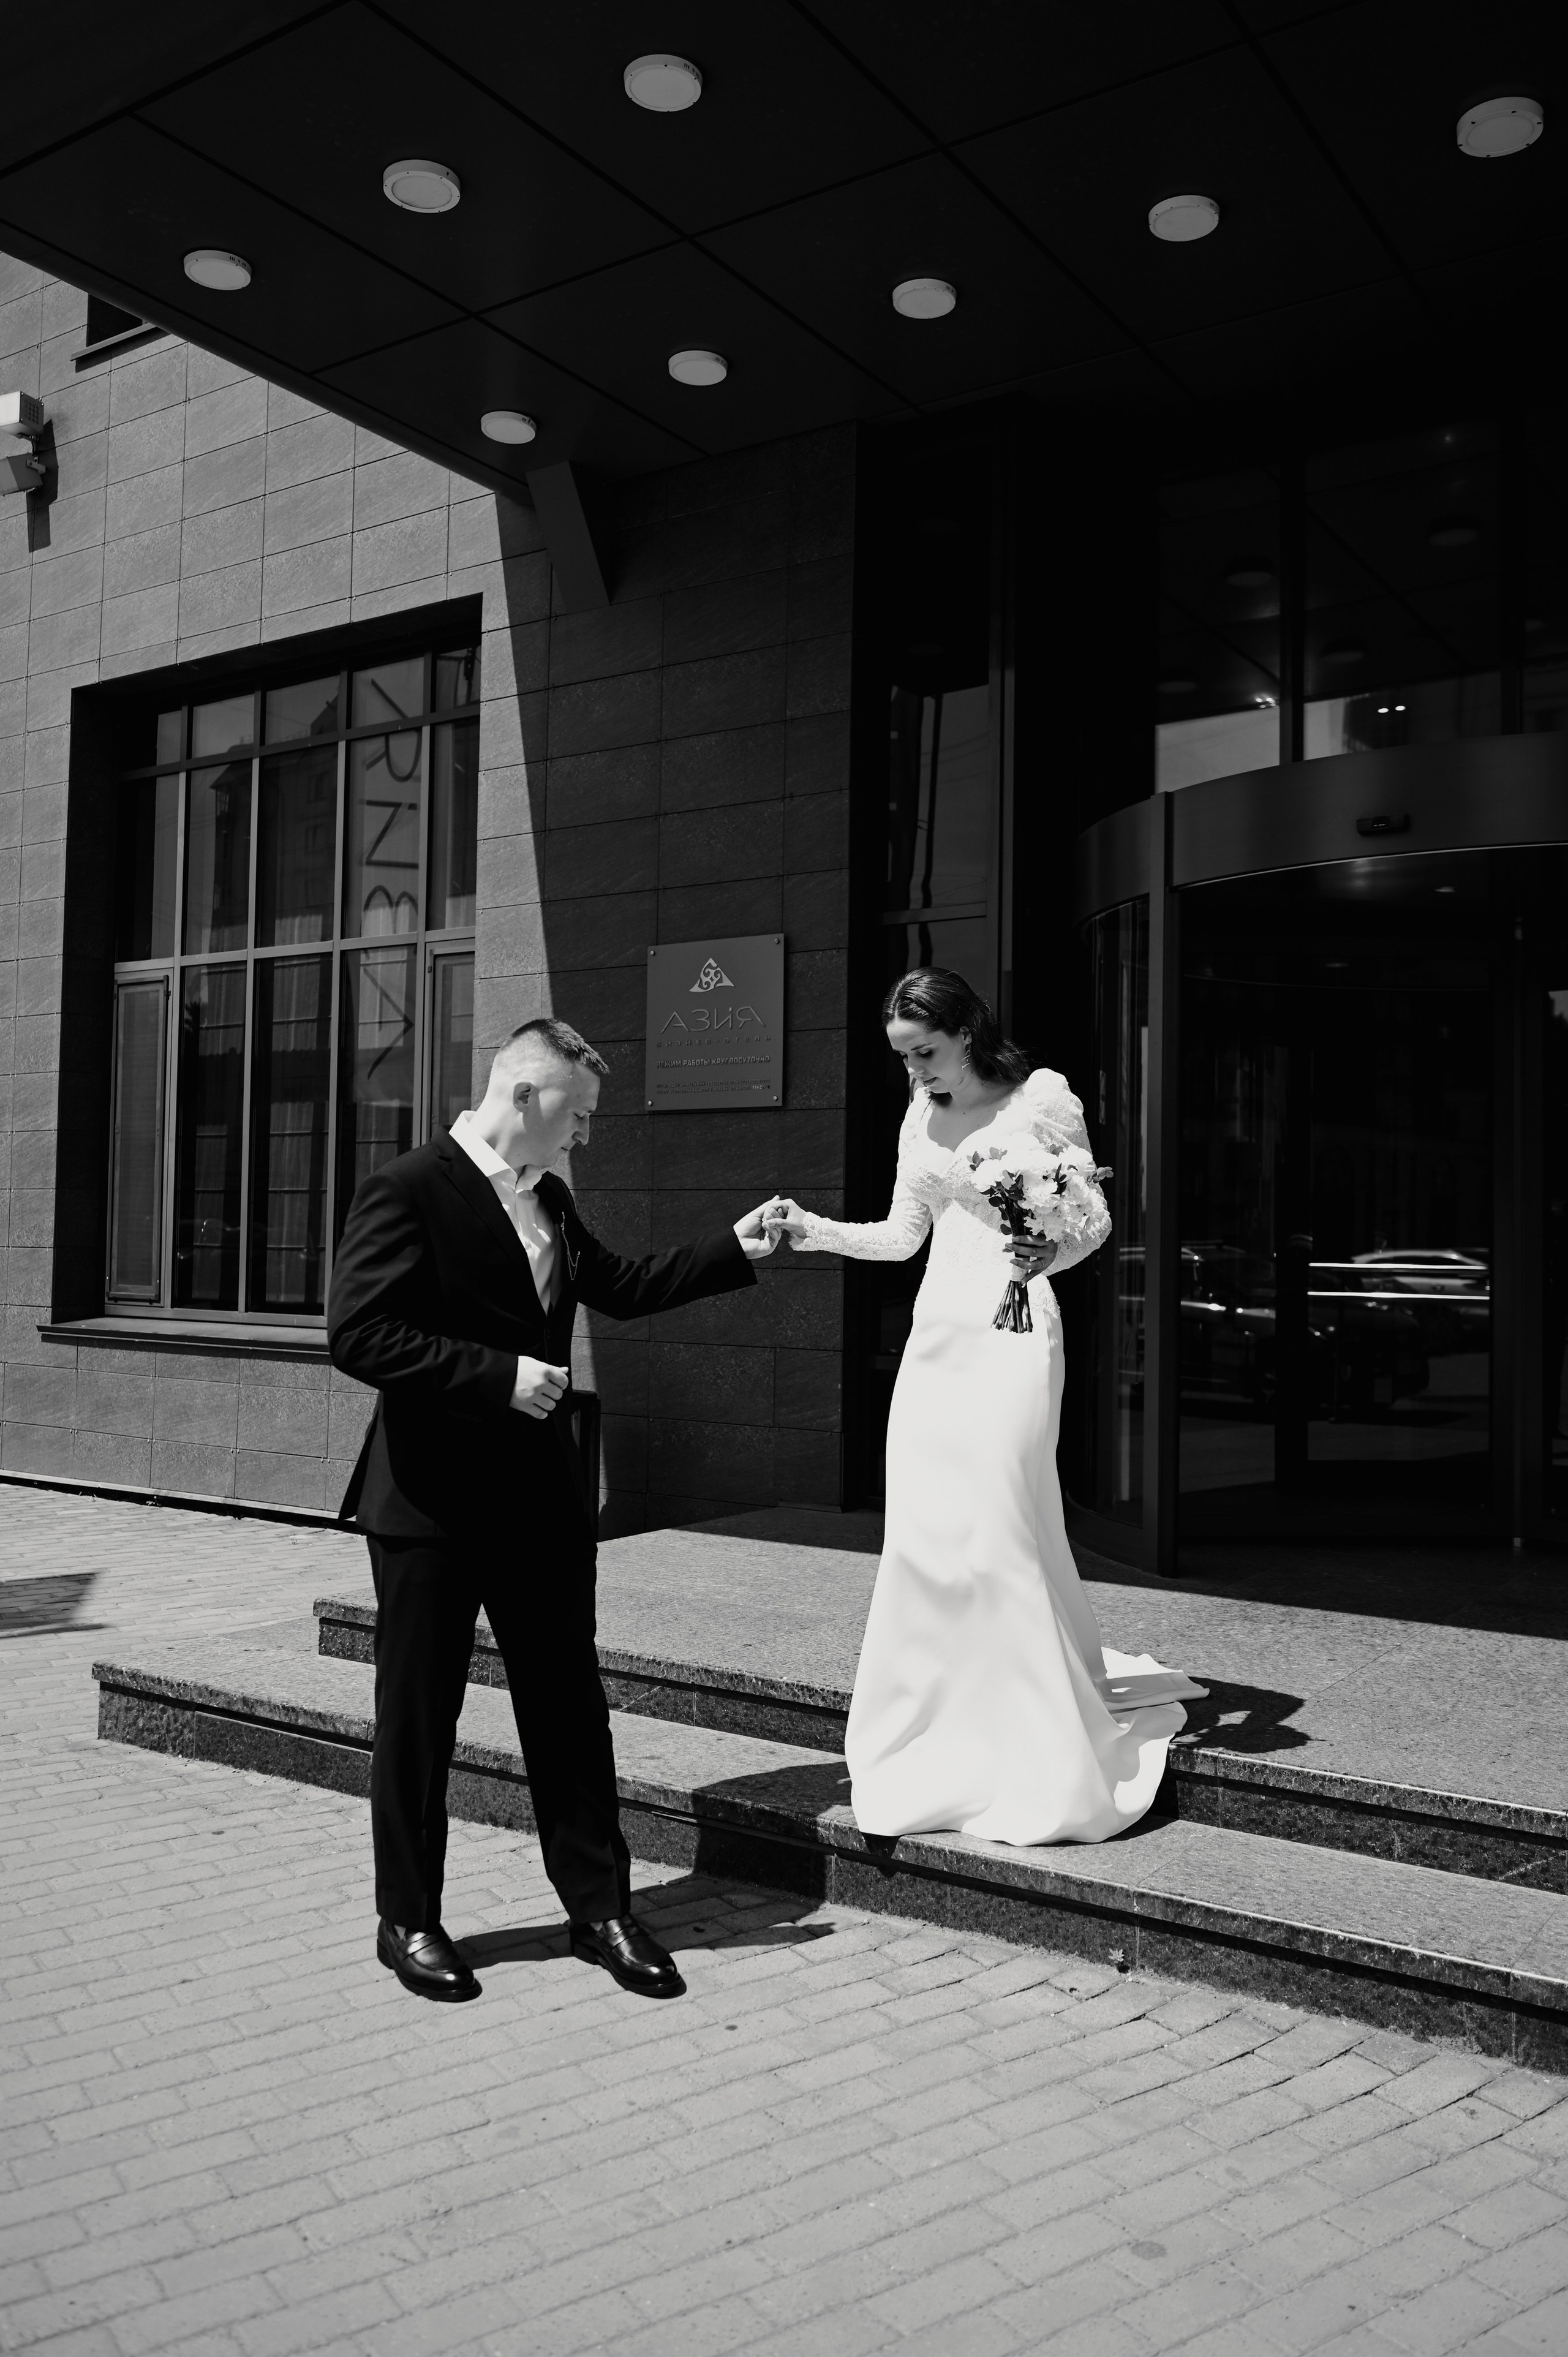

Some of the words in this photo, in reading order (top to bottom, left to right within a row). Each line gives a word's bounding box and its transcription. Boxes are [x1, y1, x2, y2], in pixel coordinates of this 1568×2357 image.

[660, 1006, 767, 1034] АЗИЯ
[656, 1036, 771, 1047] БИЗНЕС-ОТЕЛЬ
[657, 1059, 682, 1068] РЕЖИМ
[683, 1058, 710, 1066] РАБОТЫ
[712, 1055, 770, 1065] КРУГЛОСУТОЧНО
